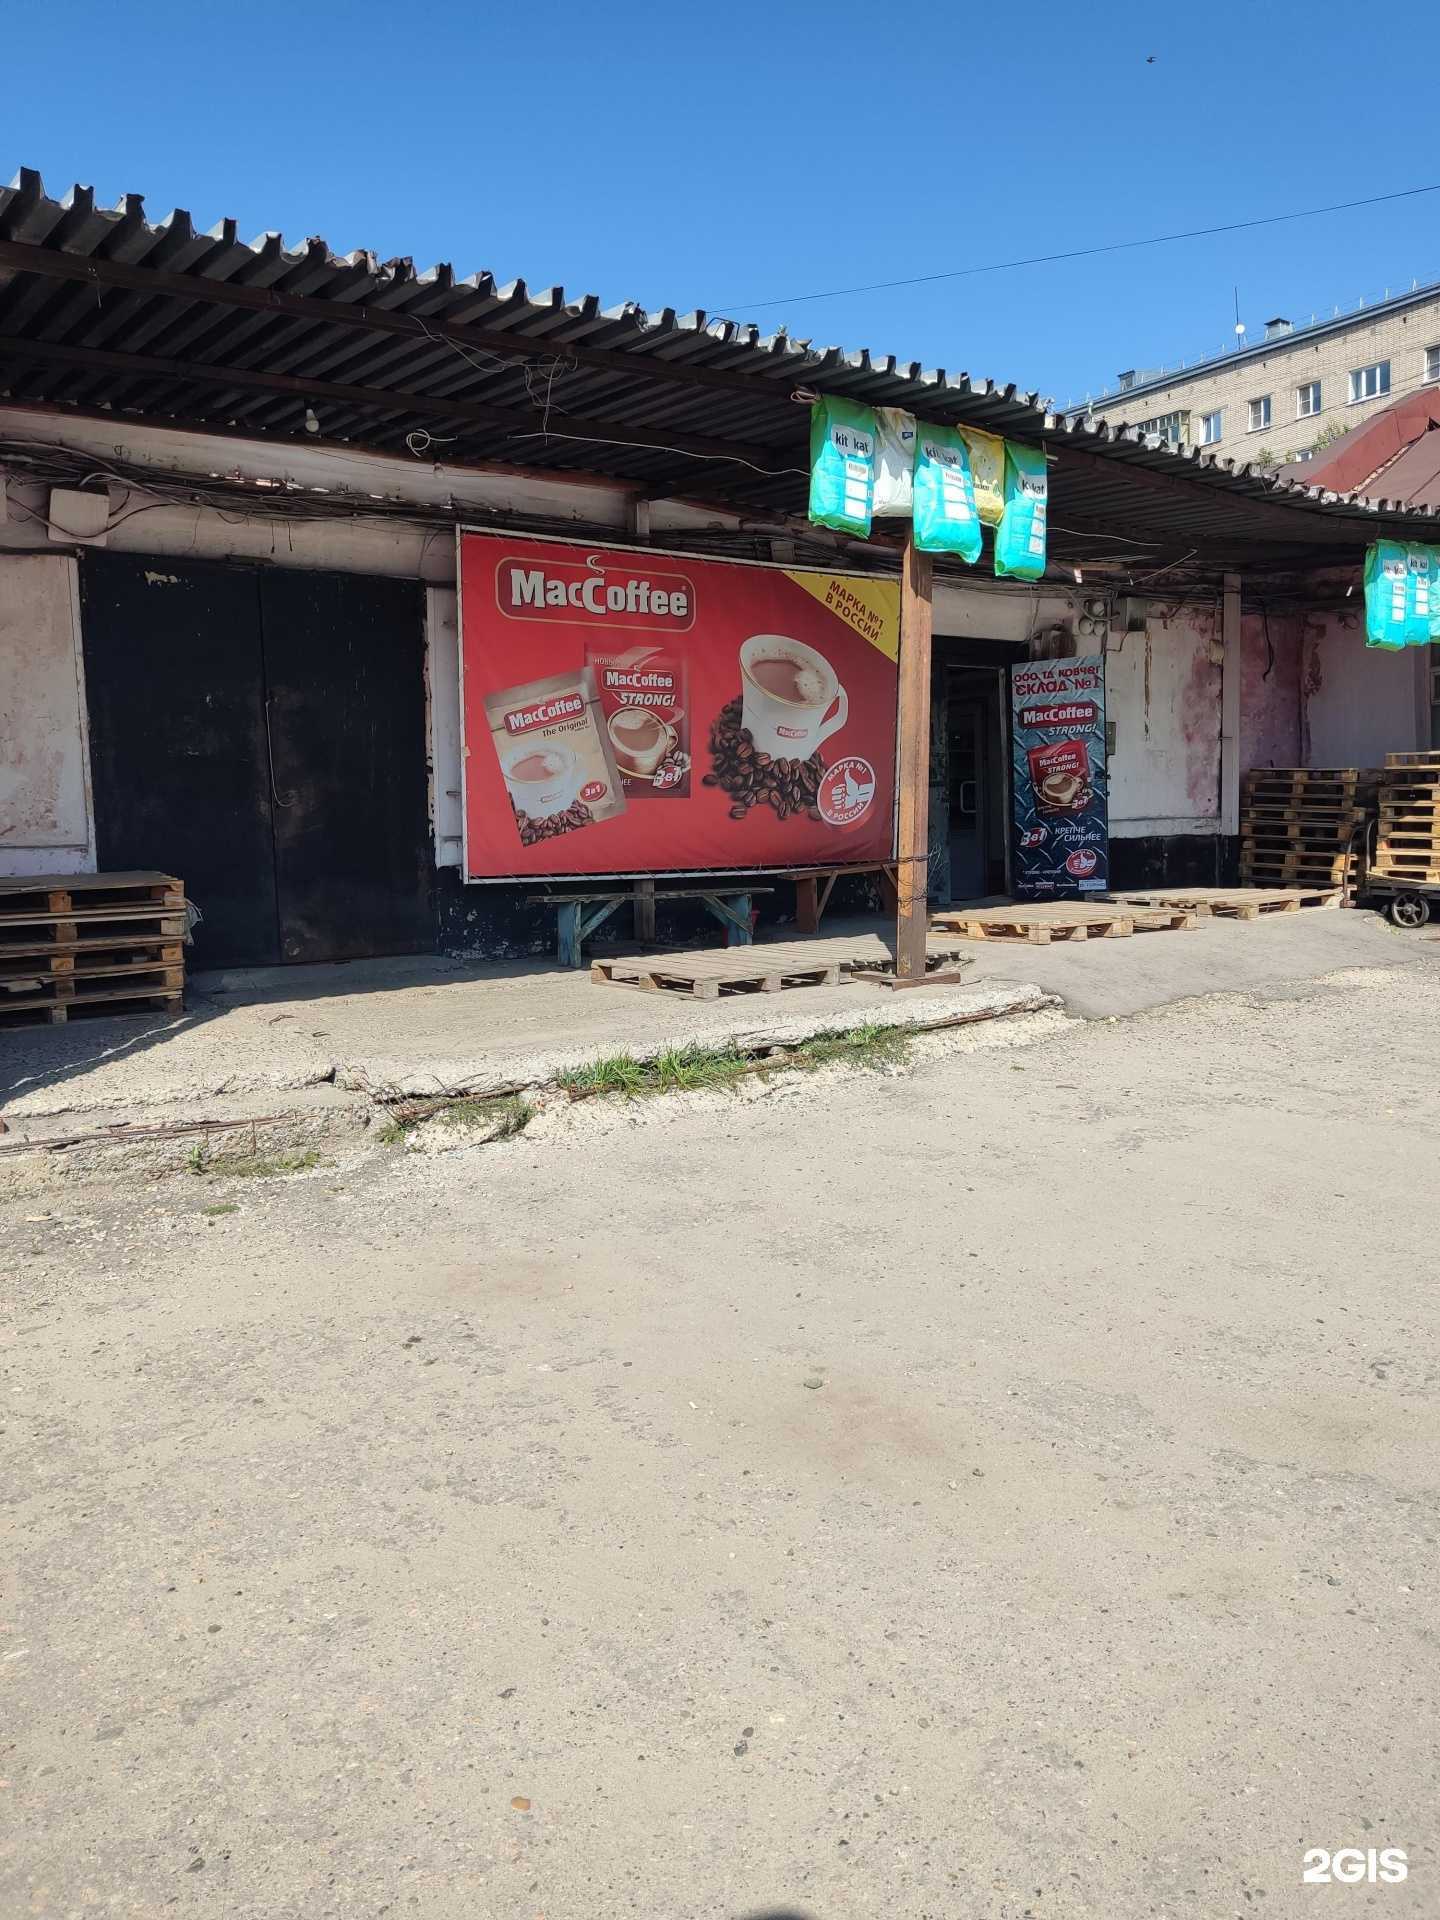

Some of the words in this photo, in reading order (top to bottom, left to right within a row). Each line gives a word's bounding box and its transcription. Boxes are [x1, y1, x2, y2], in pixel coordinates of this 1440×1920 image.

[835, 432, 848, 447] kit
[853, 437, 869, 453] kat
[510, 568, 688, 617] MacCoffee
[829, 580, 866, 616] МАРКА
[867, 610, 884, 630] №1
[825, 592, 834, 604] В
[834, 600, 880, 641] РОССИИ
[606, 671, 673, 688] MacCoffee
[620, 692, 676, 706] STRONG!
[508, 699, 582, 731] MacCoffee
[1023, 705, 1093, 724] MacCoffee
[542, 727, 557, 738] The
[558, 718, 589, 732] Original
[1049, 723, 1097, 736] STRONG!
[1039, 753, 1077, 767] MacCoffee
[1047, 761, 1079, 774] STRONG!
[827, 761, 854, 782] МАРКА
[833, 802, 864, 820] РОССИИ
[1055, 826, 1086, 835] КРЕПЧЕ
[1064, 833, 1102, 842] СИЛЬНЕЕ
